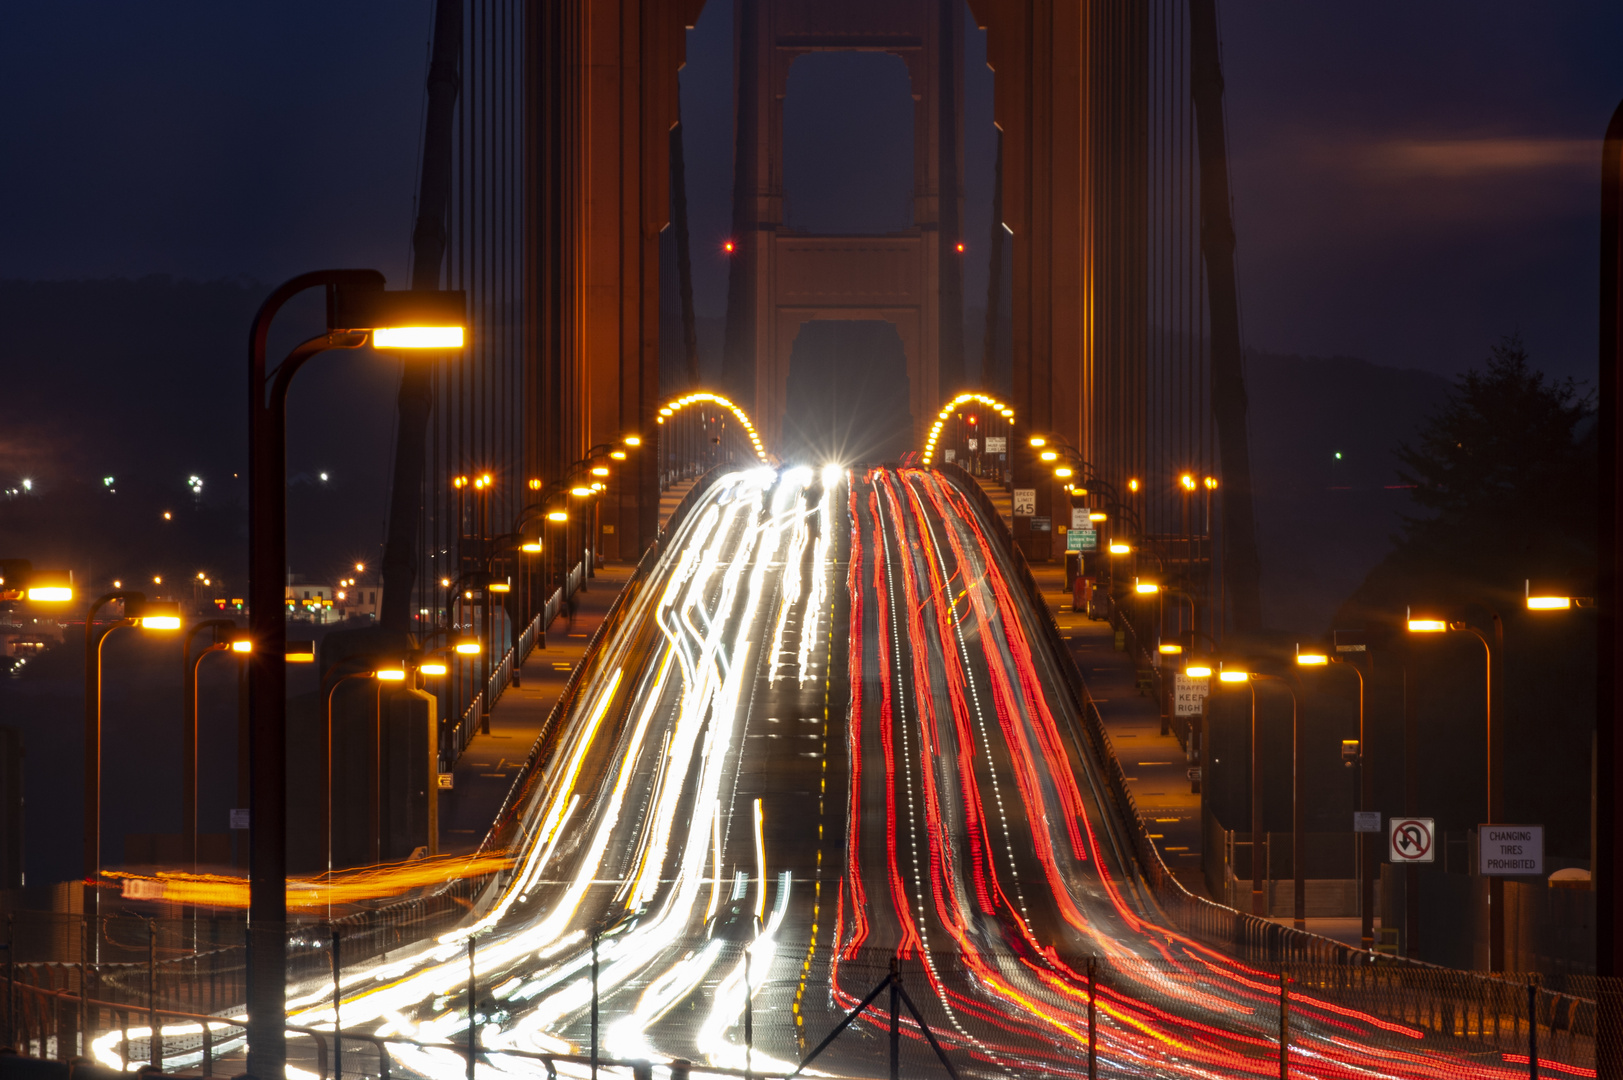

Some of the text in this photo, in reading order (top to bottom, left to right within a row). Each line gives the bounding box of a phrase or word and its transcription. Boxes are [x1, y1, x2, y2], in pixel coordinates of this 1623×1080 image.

[1016, 504, 1034, 514] 45
[1490, 832, 1531, 841] CHANGING
[1500, 845, 1522, 854] TIRES
[1488, 859, 1536, 869] PROHIBITED
